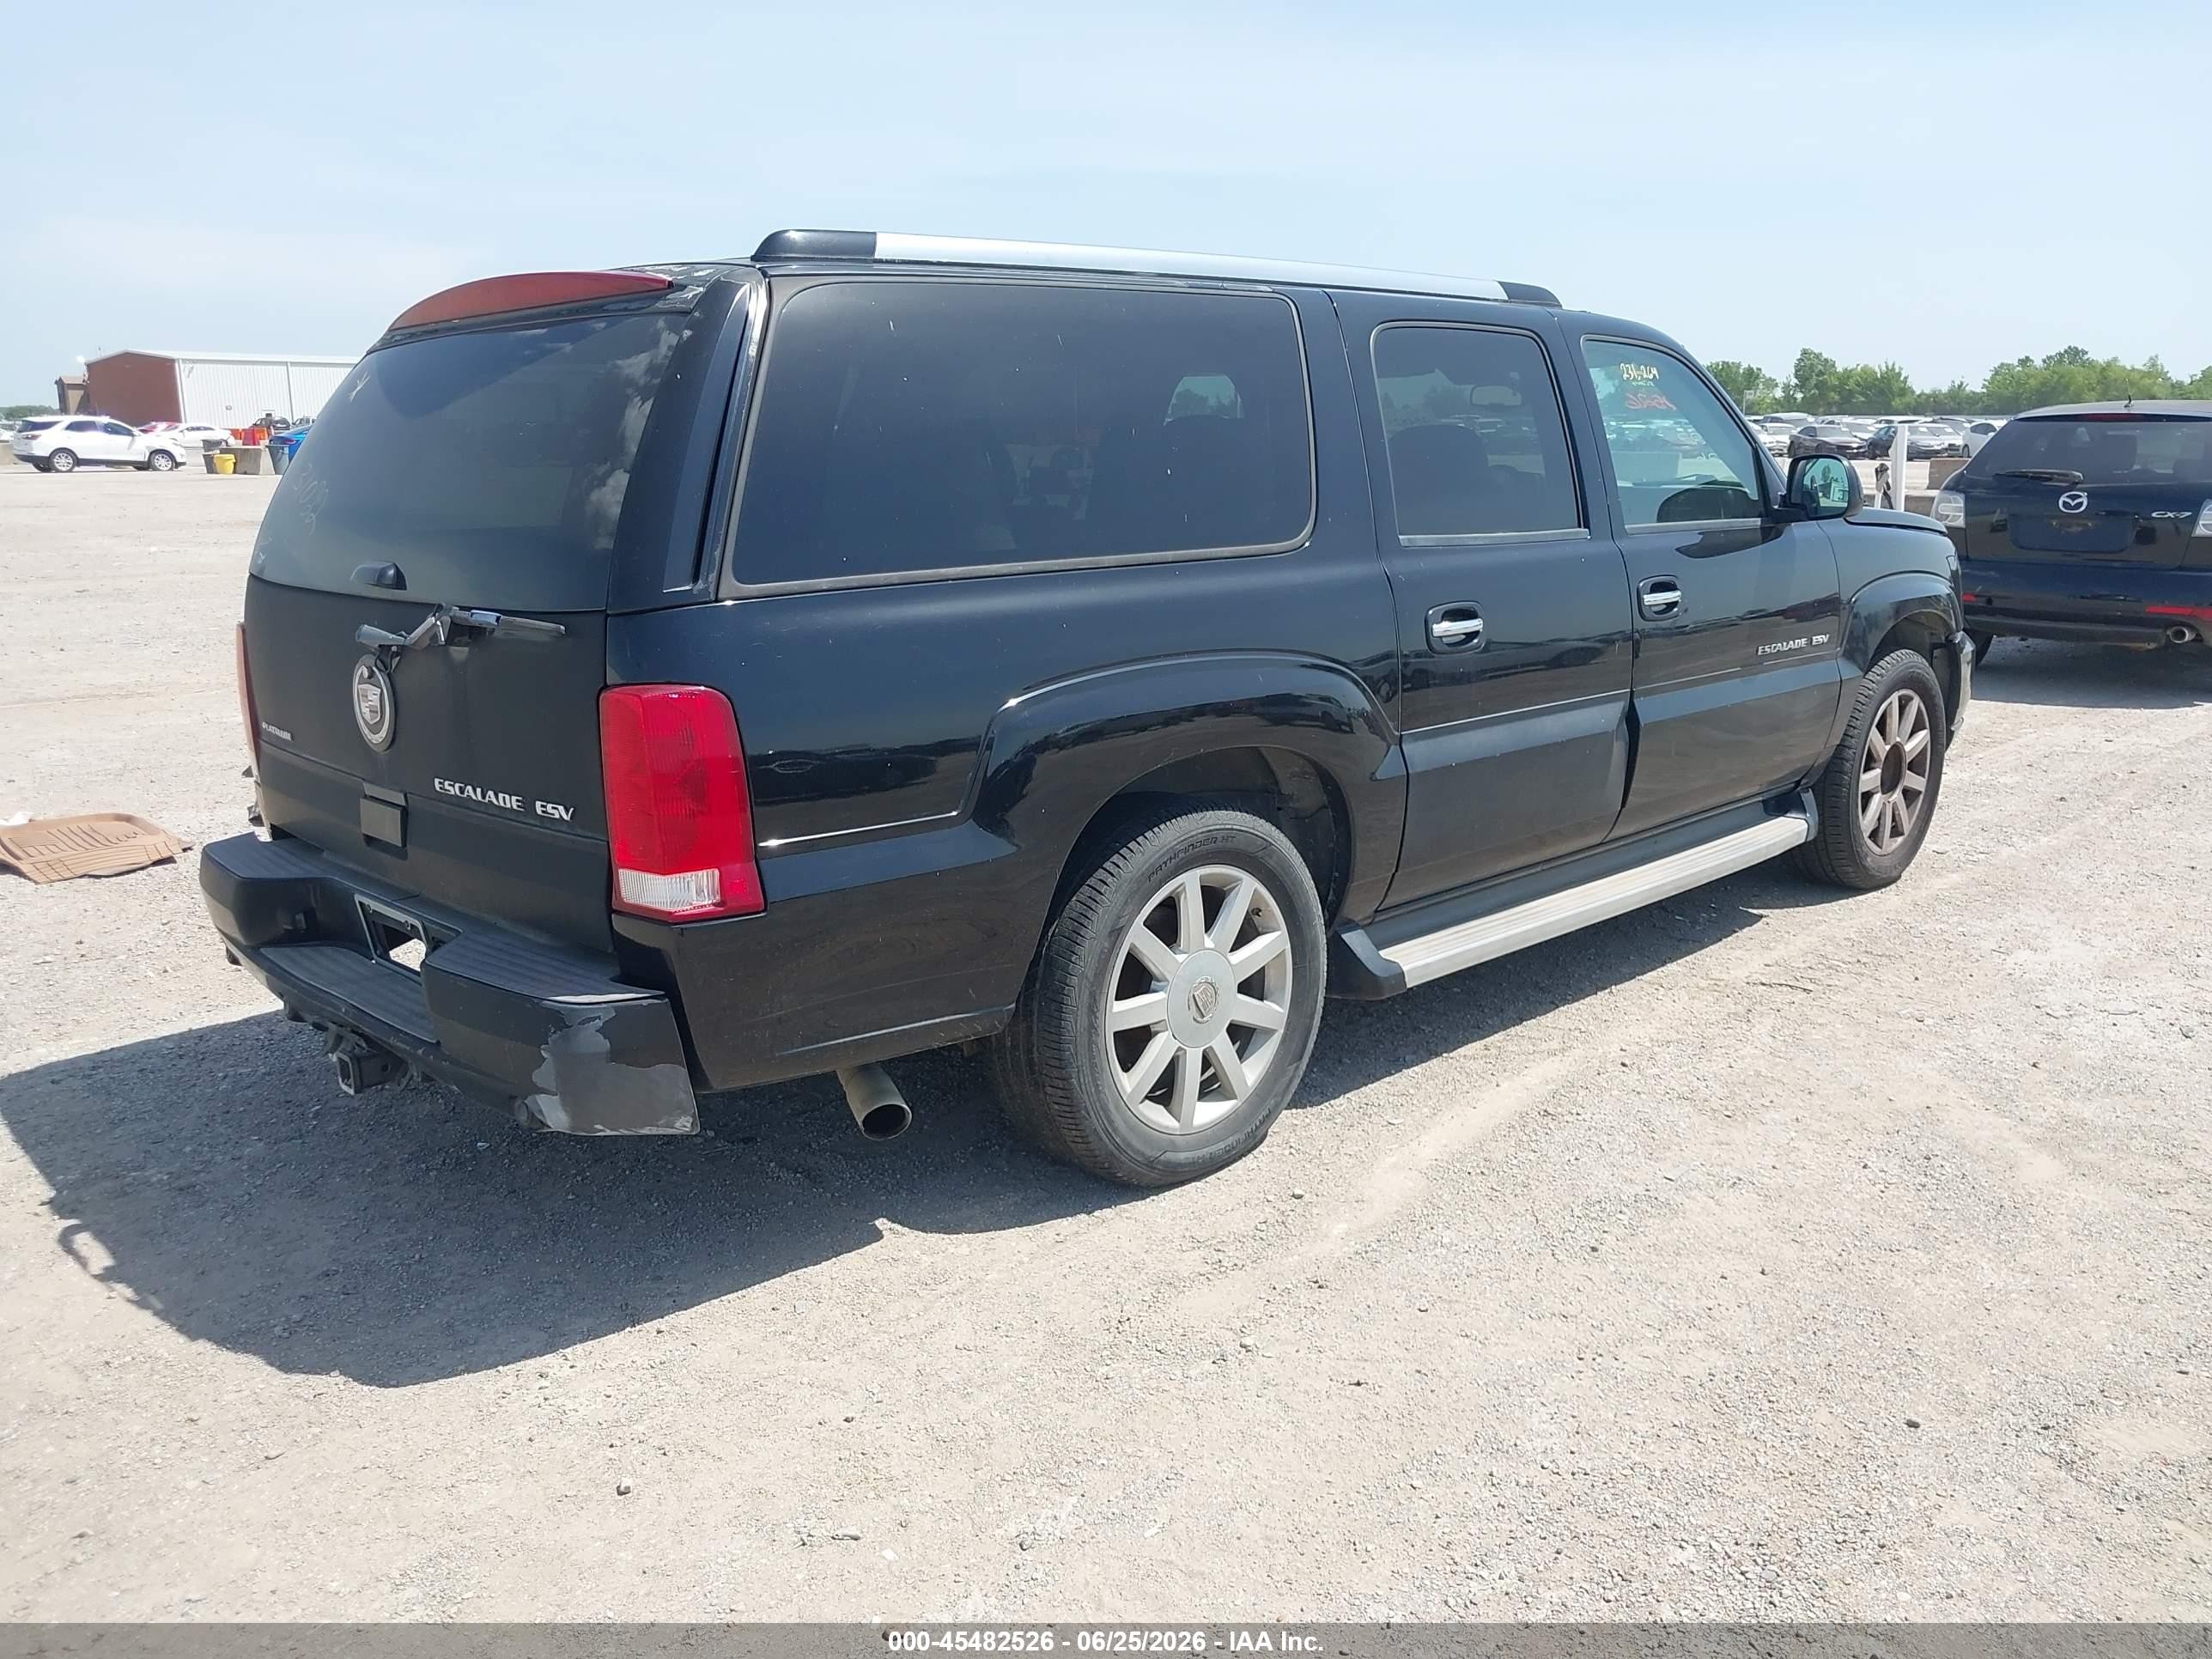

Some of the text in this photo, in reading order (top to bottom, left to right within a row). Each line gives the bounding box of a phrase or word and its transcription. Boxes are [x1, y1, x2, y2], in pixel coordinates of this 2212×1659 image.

[1758, 634, 1830, 655] ESCALADE ESV
[434, 777, 574, 822] ESCALADE ESV
[1147, 836, 1218, 883] PATHFINDER
